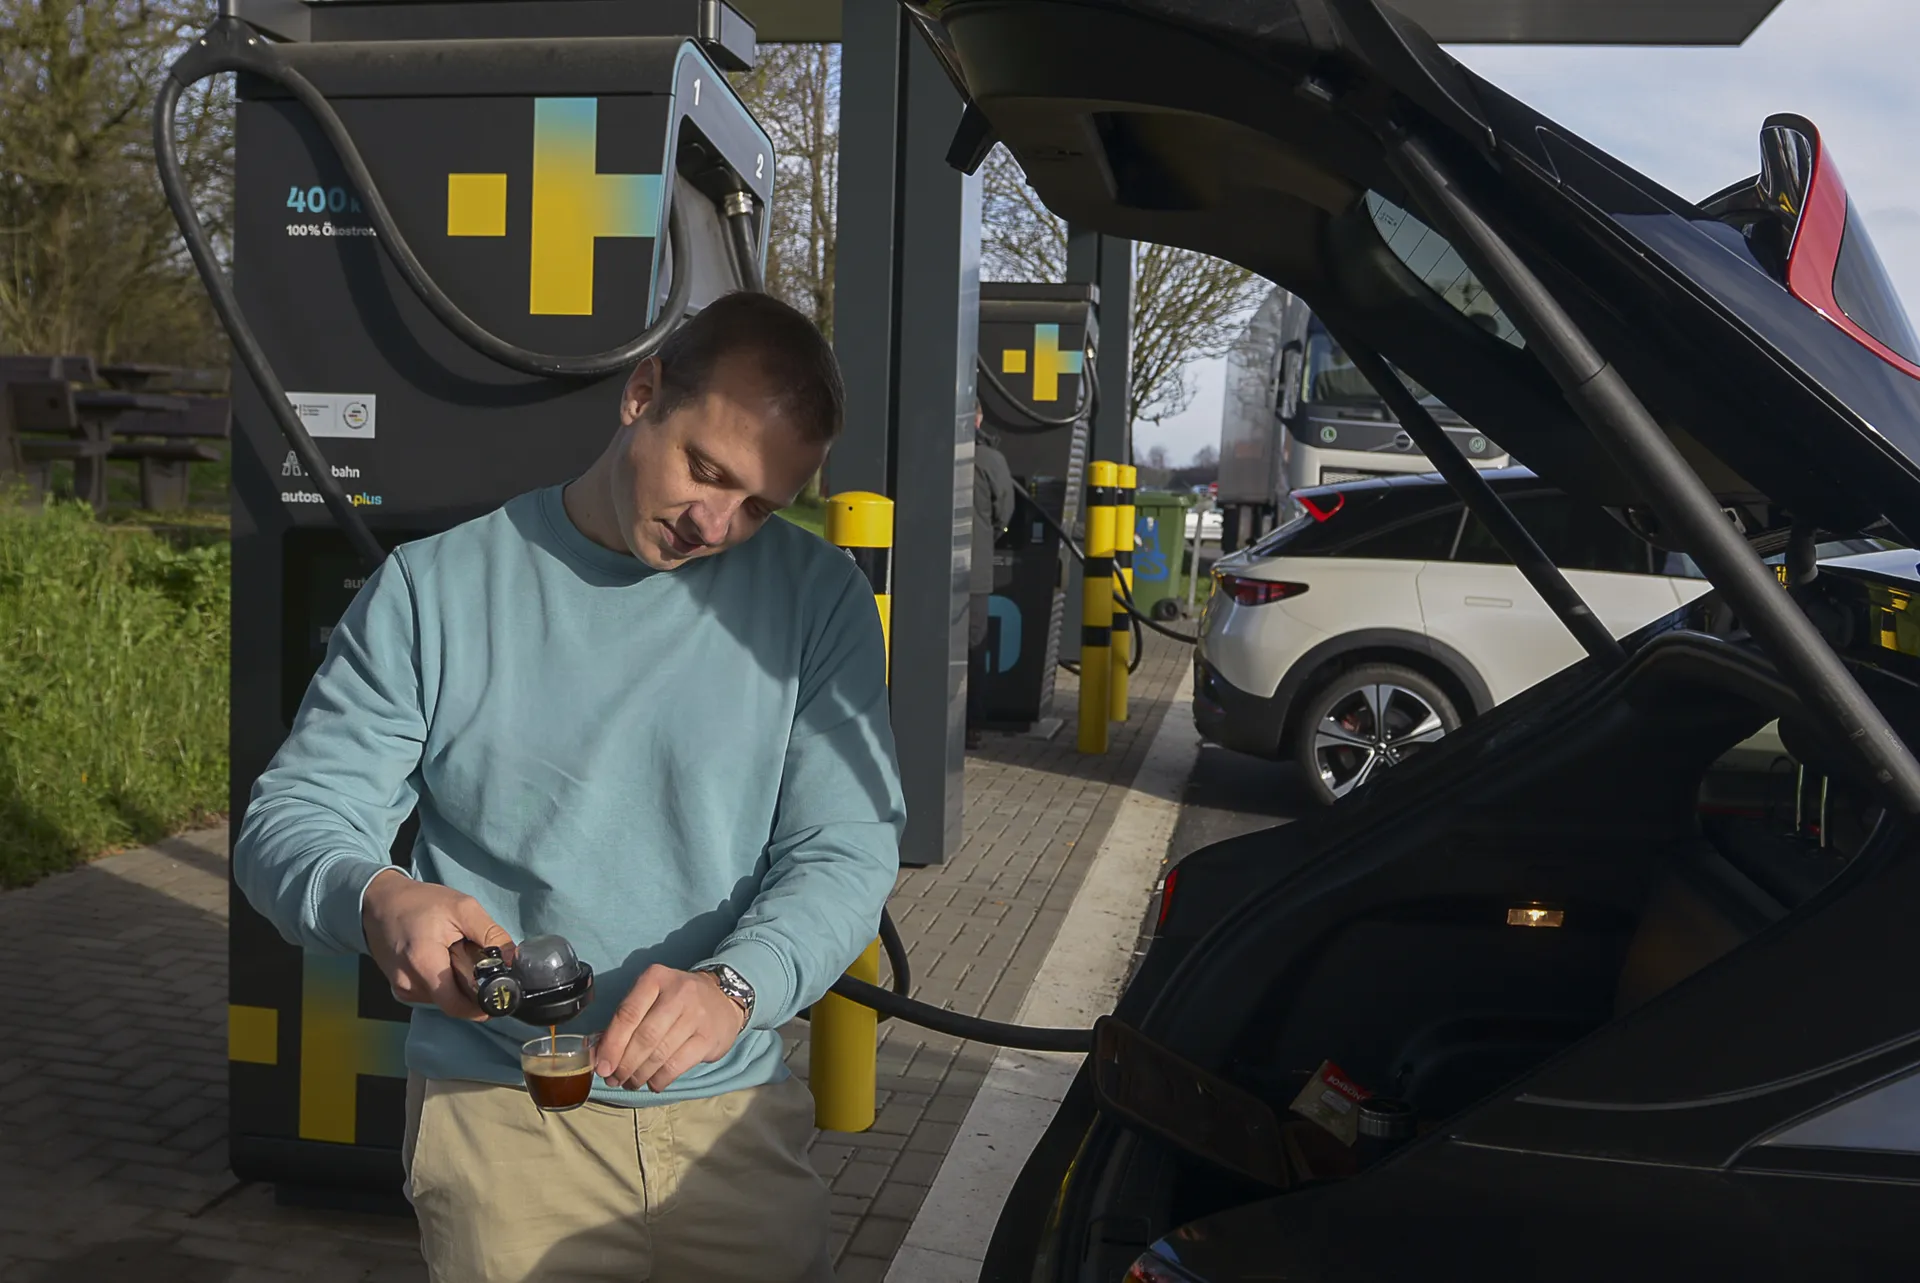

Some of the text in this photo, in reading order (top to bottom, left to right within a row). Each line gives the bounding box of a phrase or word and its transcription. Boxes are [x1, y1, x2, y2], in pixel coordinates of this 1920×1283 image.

[694, 78, 701, 106] 1
[755, 153, 764, 179] 2
[286, 185, 347, 213] 400
